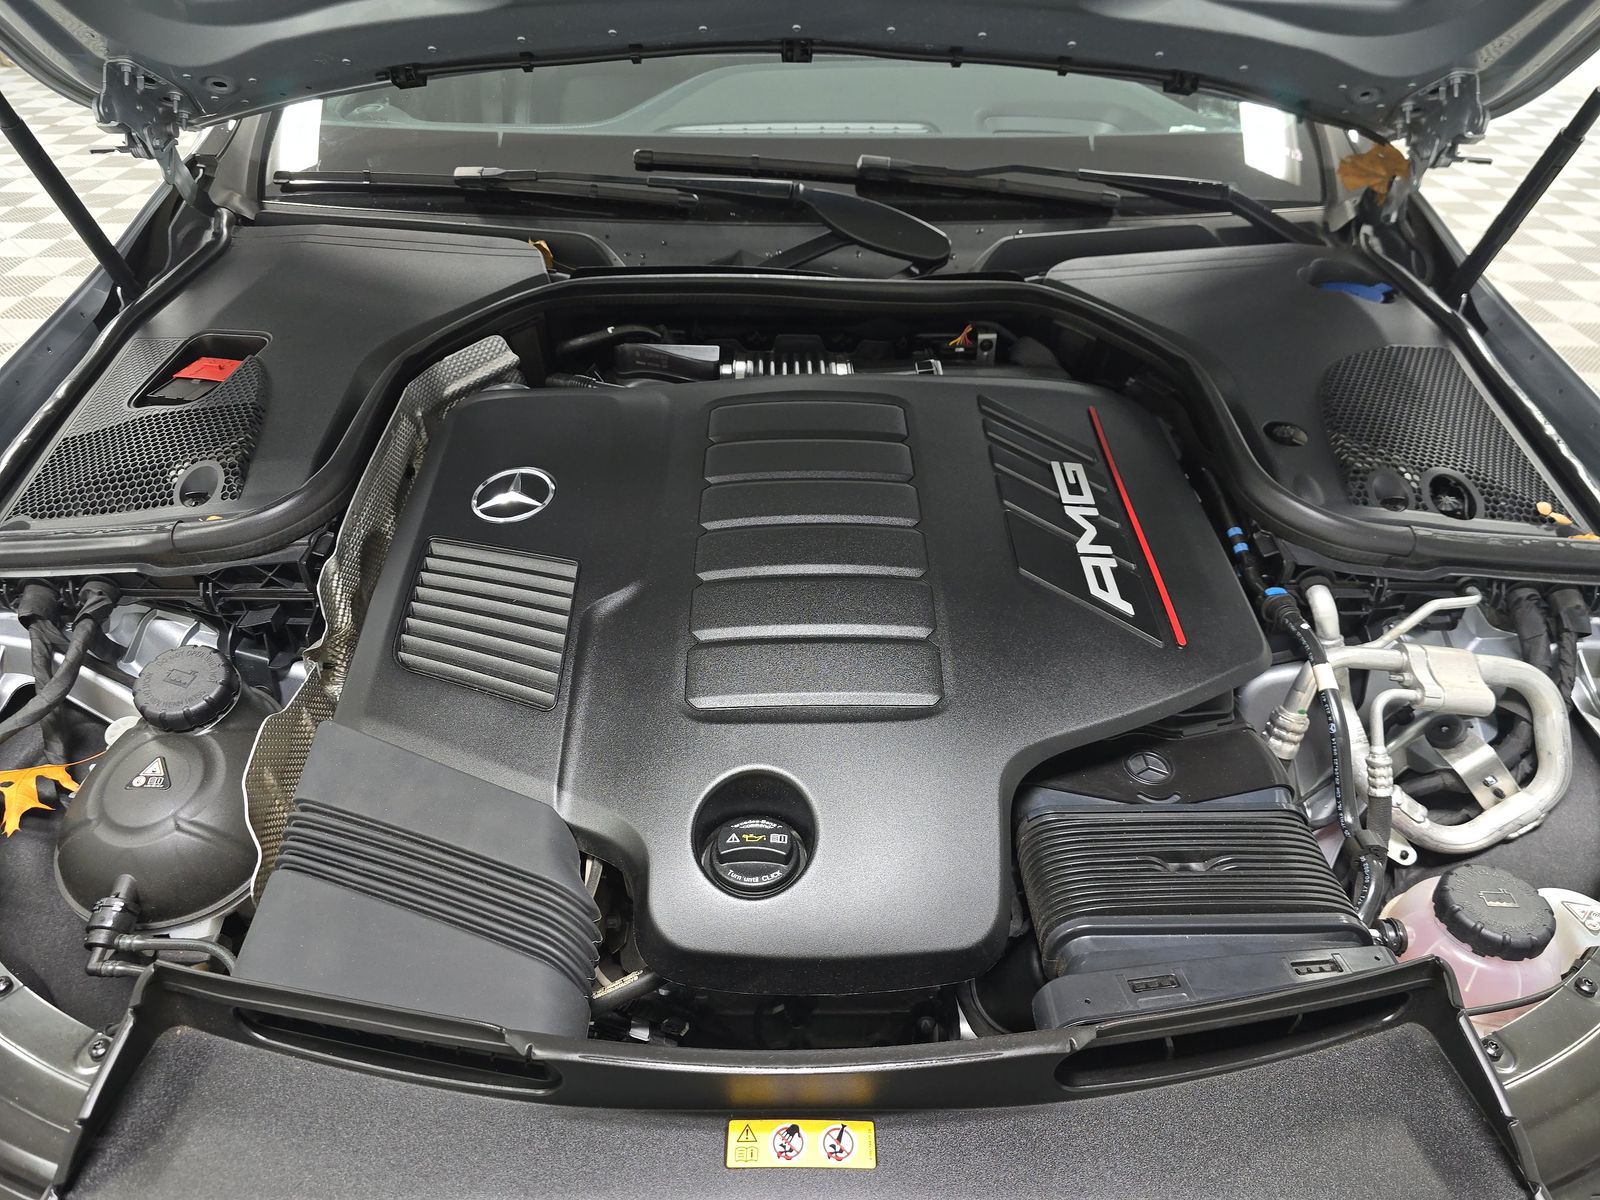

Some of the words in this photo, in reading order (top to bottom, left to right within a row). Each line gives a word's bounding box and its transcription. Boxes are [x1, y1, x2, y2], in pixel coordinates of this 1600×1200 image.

[1050, 461, 1135, 616] AMG
[187, 650, 206, 659] OPEN
[727, 869, 742, 880] Turn
[761, 870, 783, 881] CLICK
